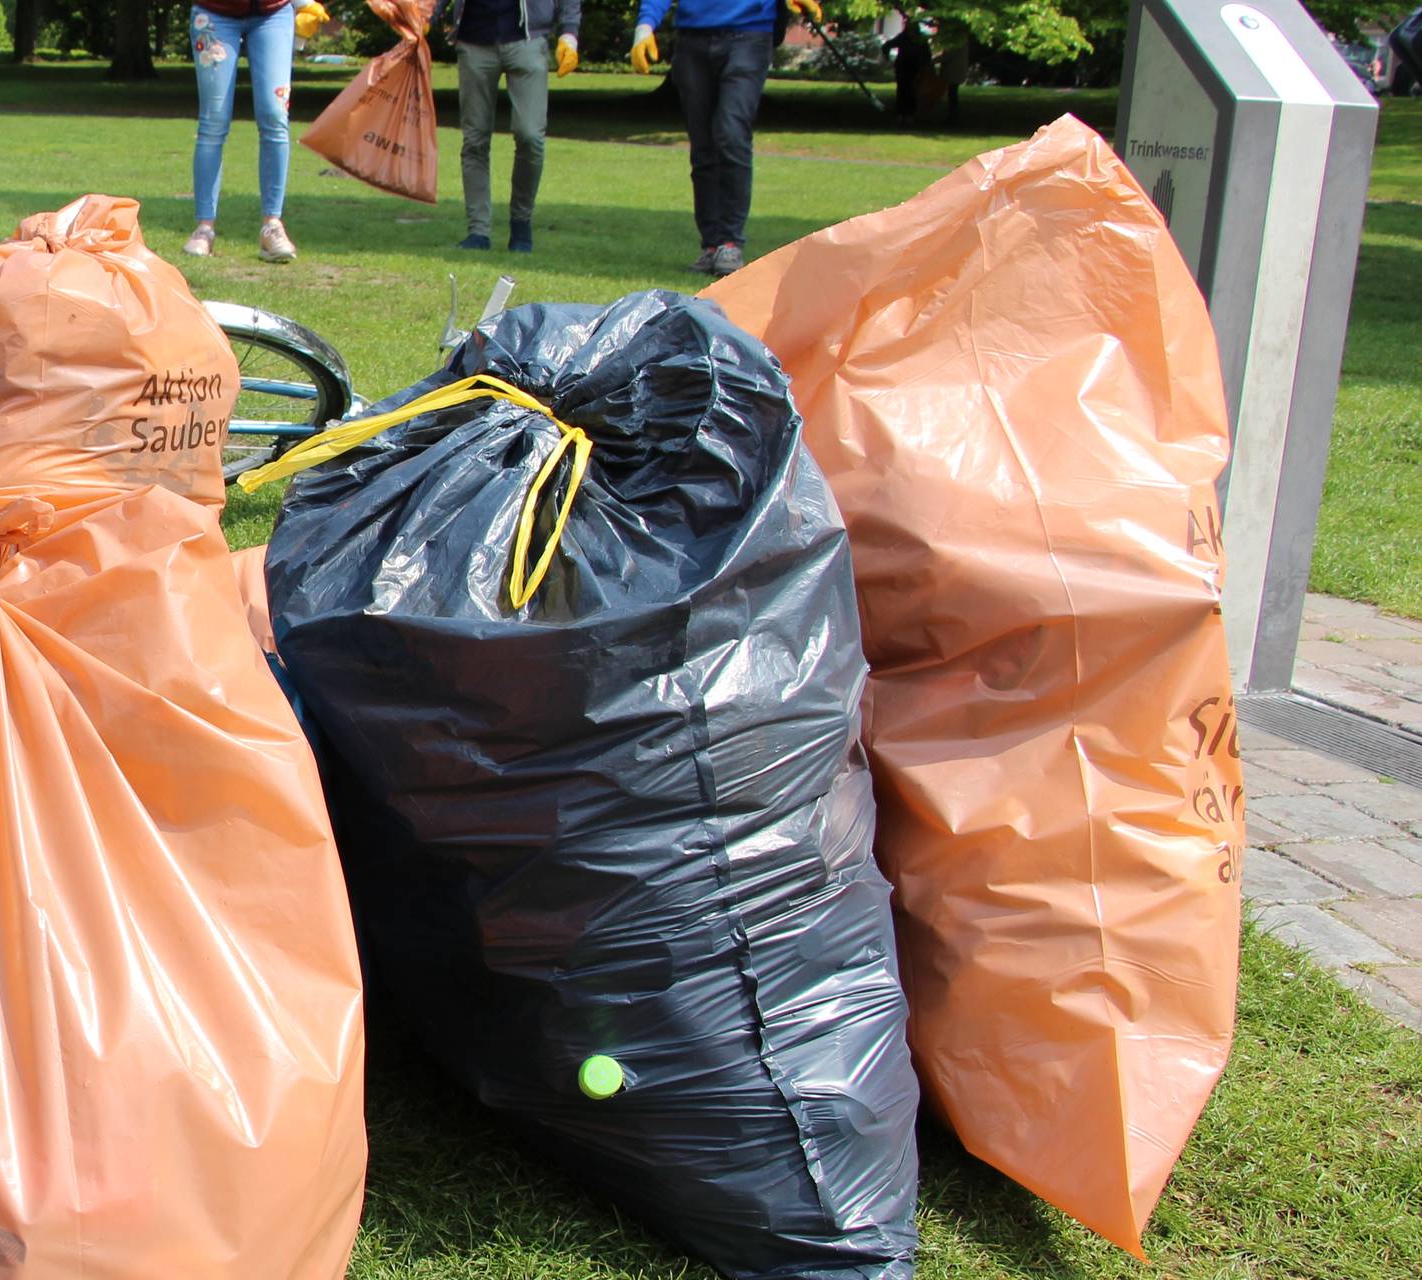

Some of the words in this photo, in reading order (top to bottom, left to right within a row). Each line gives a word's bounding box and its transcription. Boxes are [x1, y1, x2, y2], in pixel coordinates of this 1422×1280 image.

[1130, 139, 1210, 160] Trinkwasser
[132, 368, 222, 407] Aktion
[130, 411, 226, 453] Sauber
